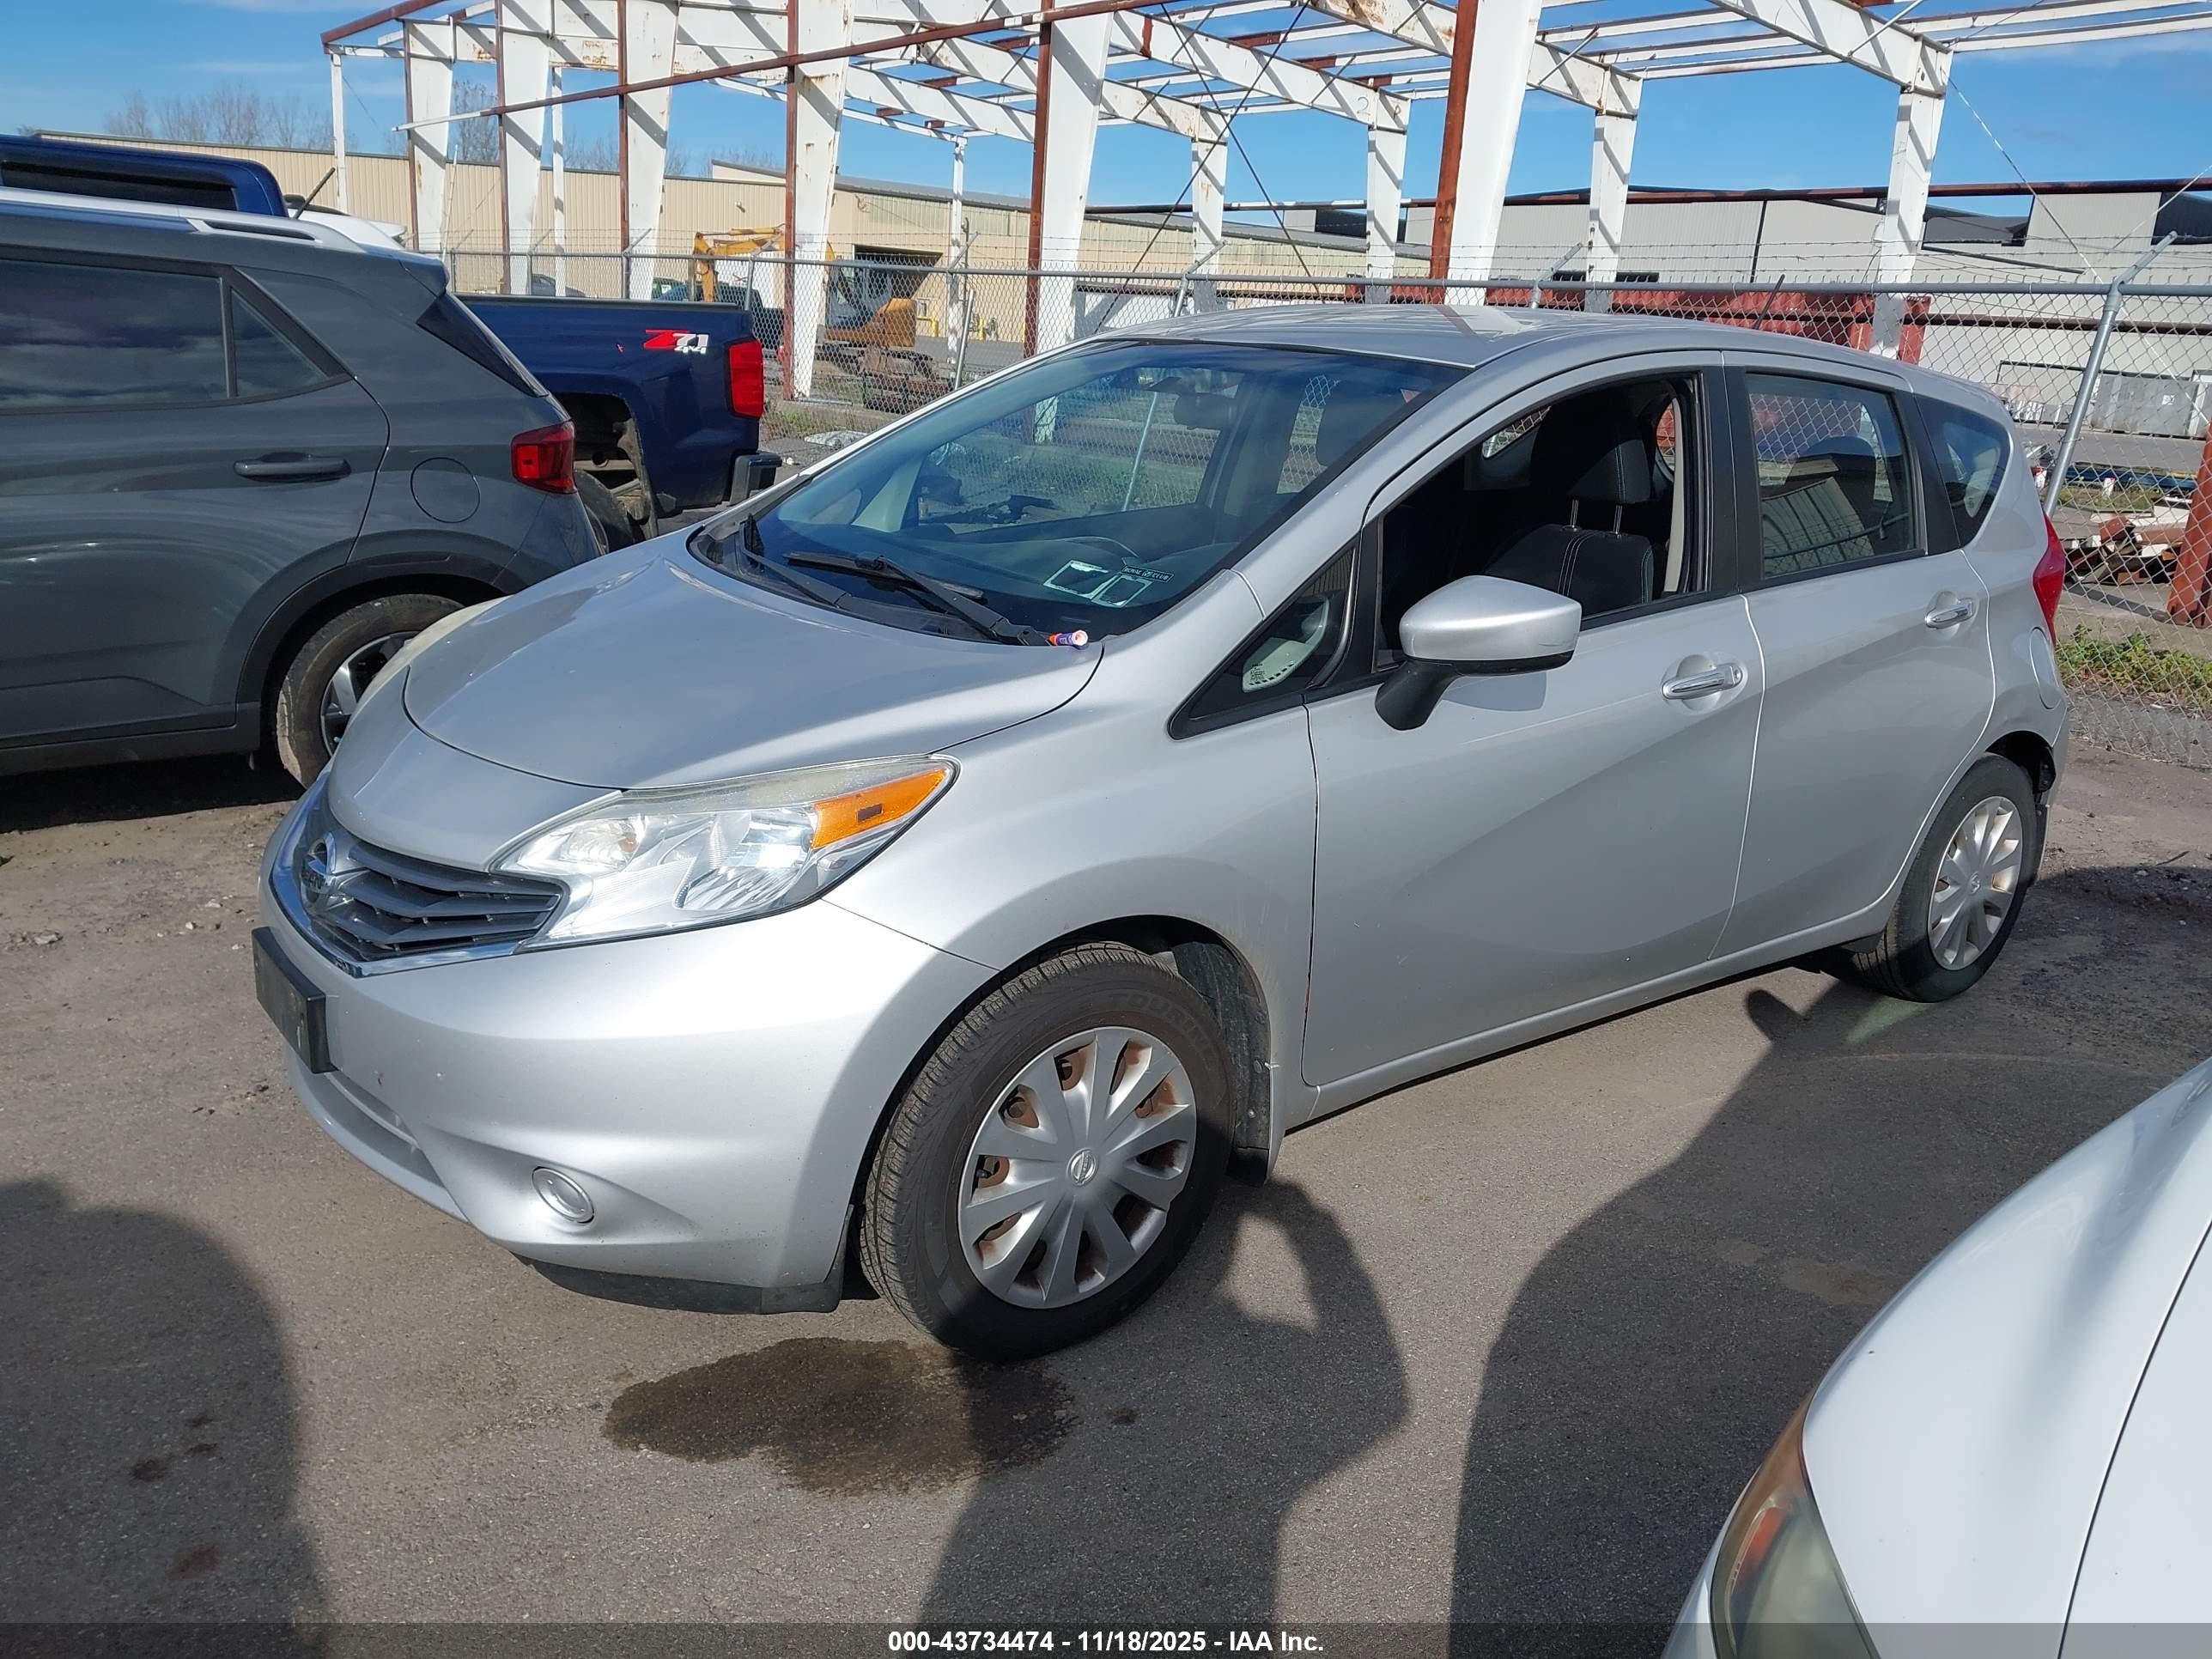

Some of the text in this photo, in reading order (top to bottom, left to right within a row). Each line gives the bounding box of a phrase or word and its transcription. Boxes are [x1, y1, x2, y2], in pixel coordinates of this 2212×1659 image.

[643, 329, 709, 351] Z71
[1152, 572, 1170, 580] CLUB
[1109, 992, 1217, 1068] TOURING
